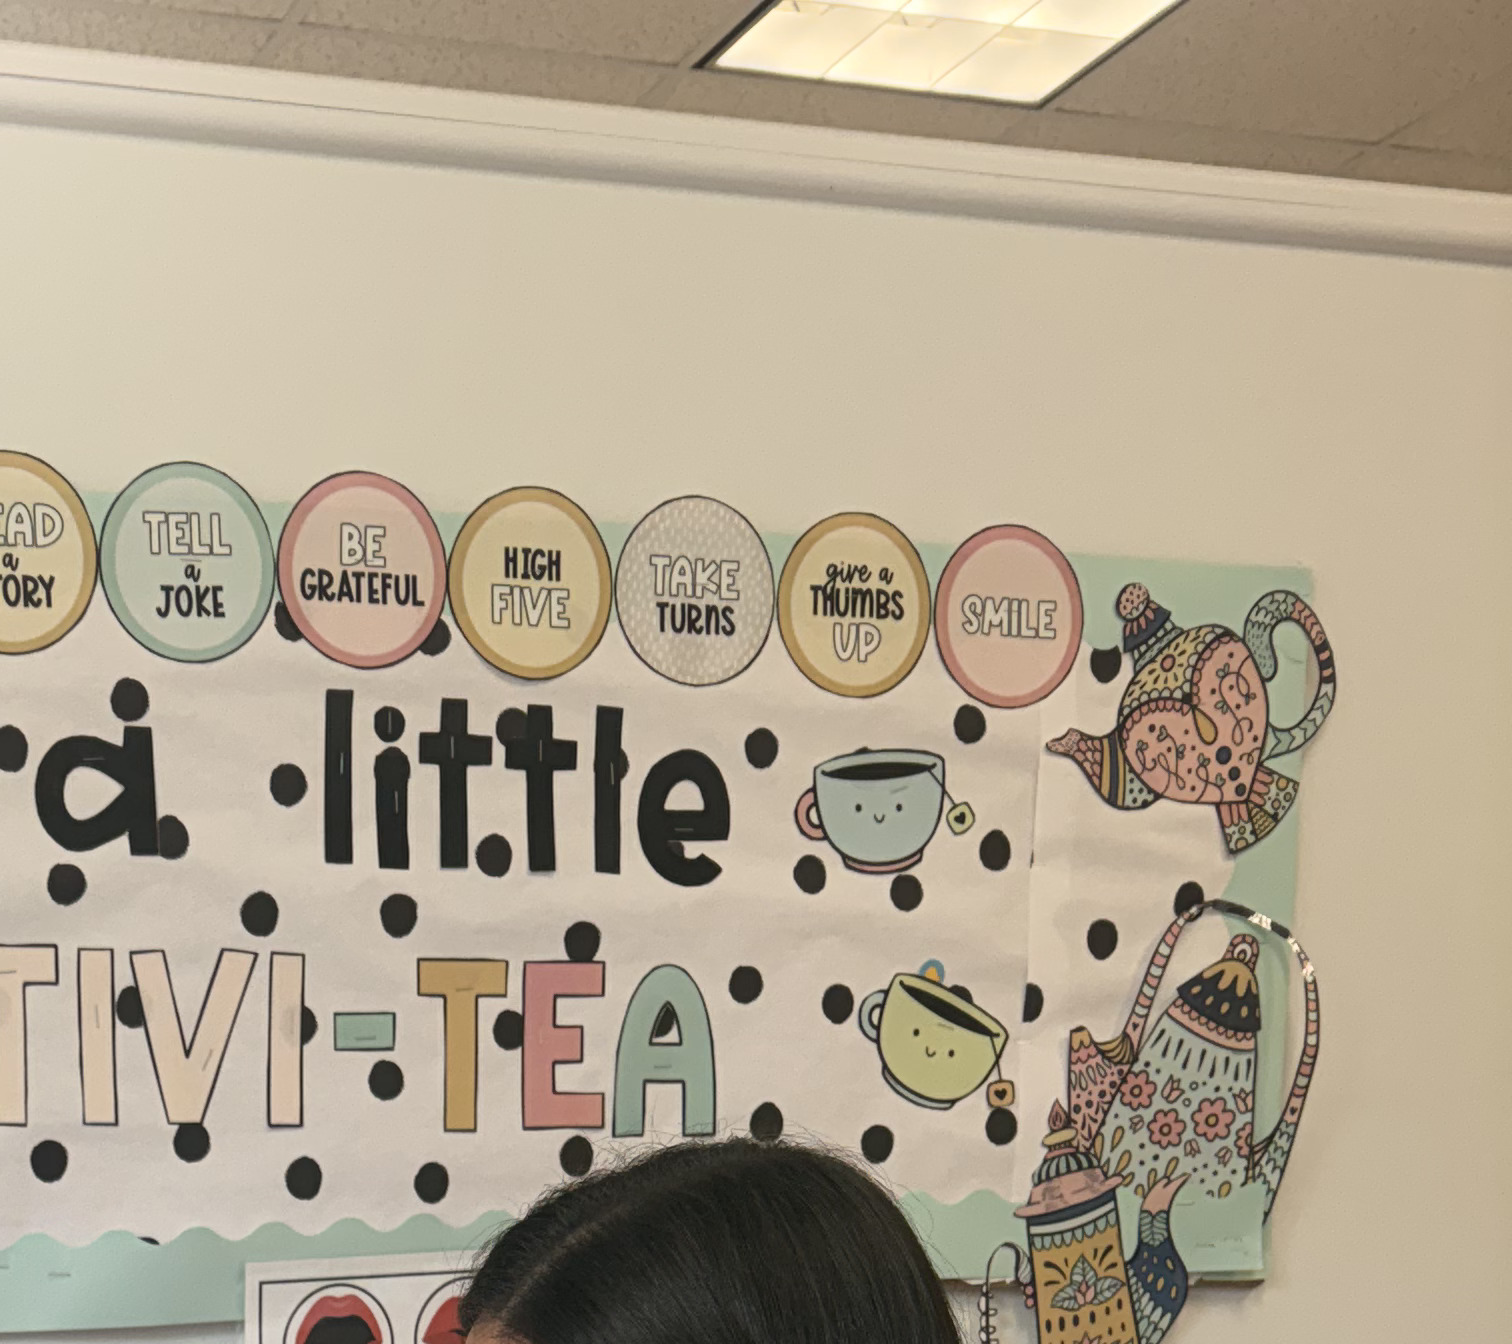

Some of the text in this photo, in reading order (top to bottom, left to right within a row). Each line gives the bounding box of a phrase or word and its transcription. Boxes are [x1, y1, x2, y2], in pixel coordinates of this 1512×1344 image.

[143, 511, 232, 557] TELL
[339, 522, 387, 568] BE
[2, 552, 20, 573] a
[184, 562, 202, 583] a
[503, 546, 562, 582] HIGH
[649, 555, 740, 601] TAKE
[826, 561, 894, 590] give a
[156, 585, 226, 619] JOKE
[299, 568, 425, 608] GRATEFUL
[491, 584, 571, 630] FIVE
[809, 584, 905, 621] THUMBS
[656, 601, 736, 637] TURNS
[961, 594, 1058, 640] SMILE
[832, 622, 882, 663] UP
[34, 725, 161, 858] a
[324, 688, 733, 888] little
